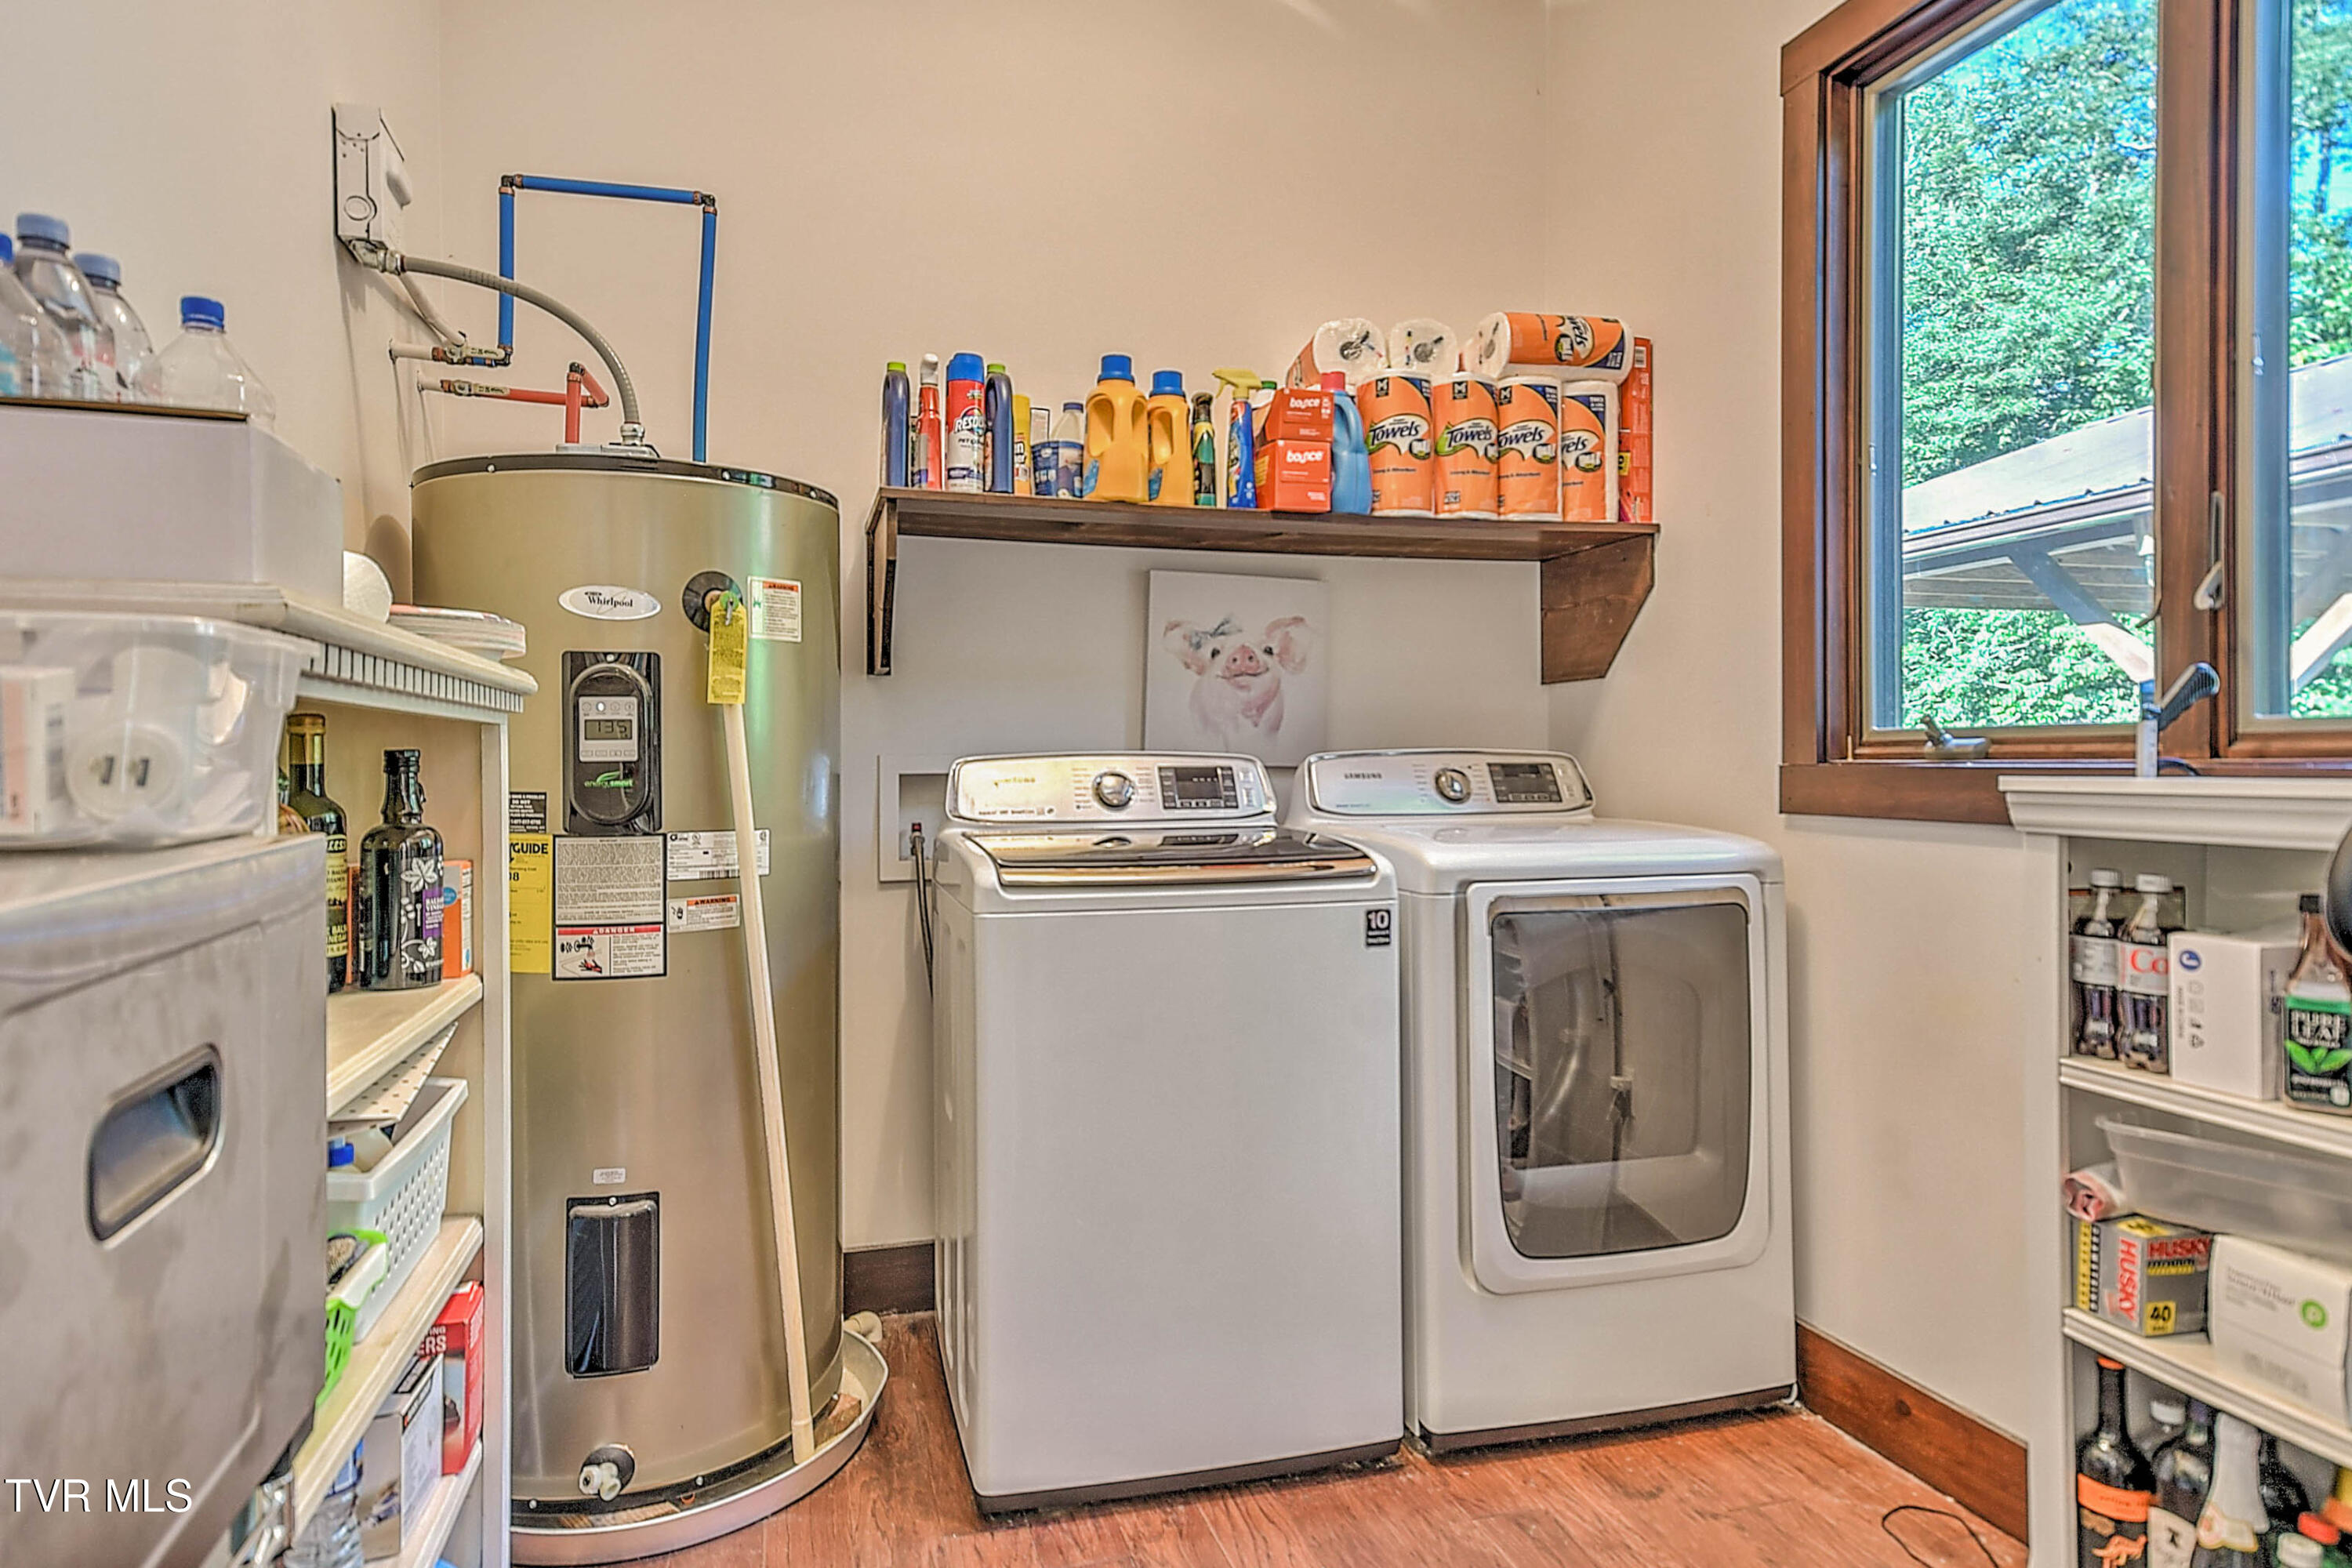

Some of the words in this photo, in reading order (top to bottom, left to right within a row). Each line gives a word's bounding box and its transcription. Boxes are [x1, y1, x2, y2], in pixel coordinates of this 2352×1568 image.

[1290, 397, 1320, 409] bounce
[1370, 421, 1420, 446] Towels
[1446, 425, 1492, 448] Towels
[1287, 449, 1323, 464] bounce
[588, 595, 633, 608] Whirlpool
[598, 720, 627, 734] 135
[1368, 911, 1389, 929] 10
[2147, 1237, 2211, 1258] HUSKY
[2119, 1239, 2138, 1322] HUSKY
[2151, 1305, 2172, 1322] 40
